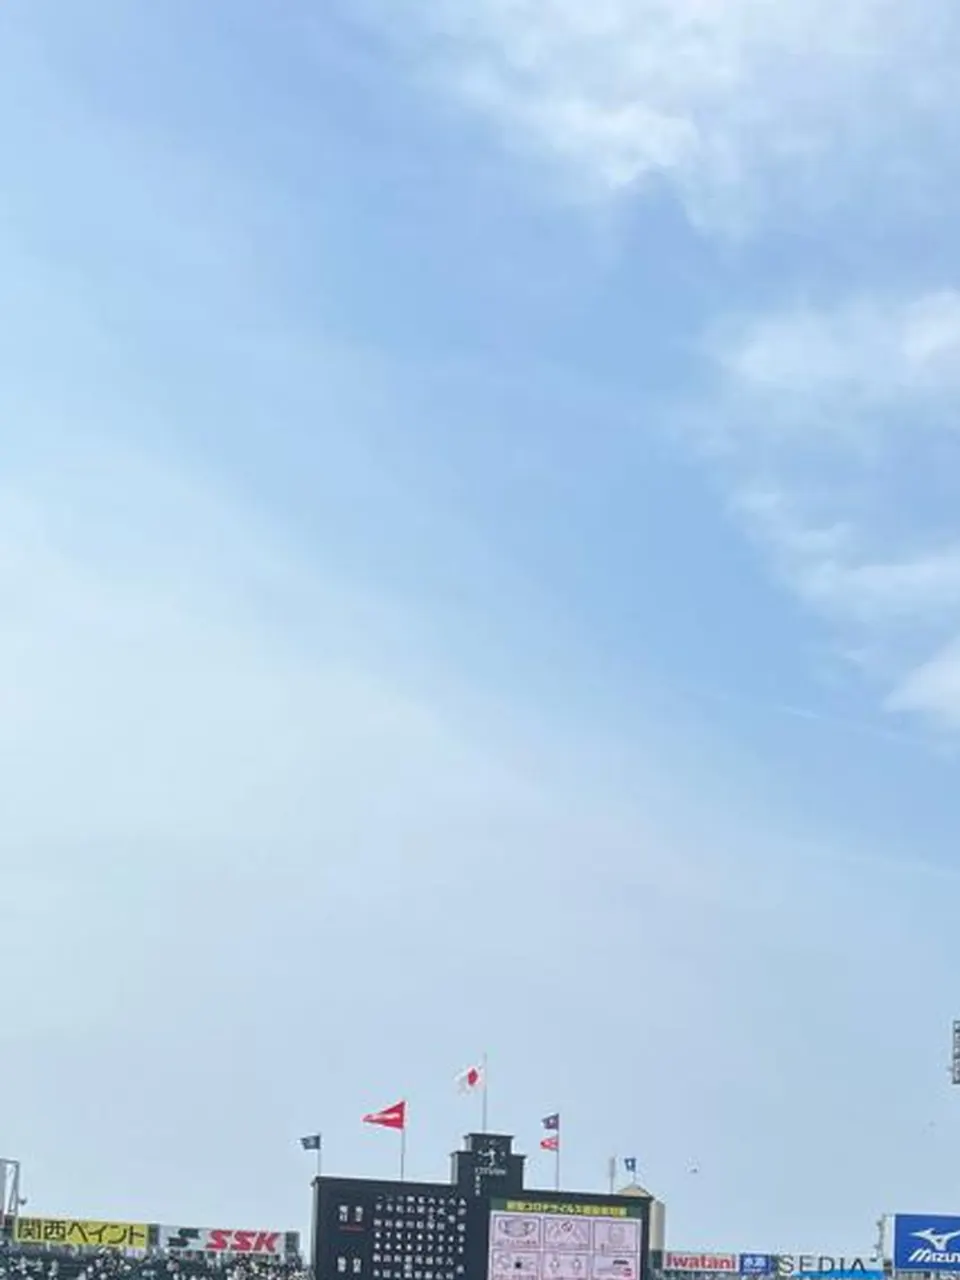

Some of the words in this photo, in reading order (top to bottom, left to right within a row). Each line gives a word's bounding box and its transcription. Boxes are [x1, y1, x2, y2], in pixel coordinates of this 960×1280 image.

[17, 1220, 146, 1246] 関西ペイント
[205, 1230, 280, 1252] SSK
[666, 1254, 736, 1270] Iwatani
